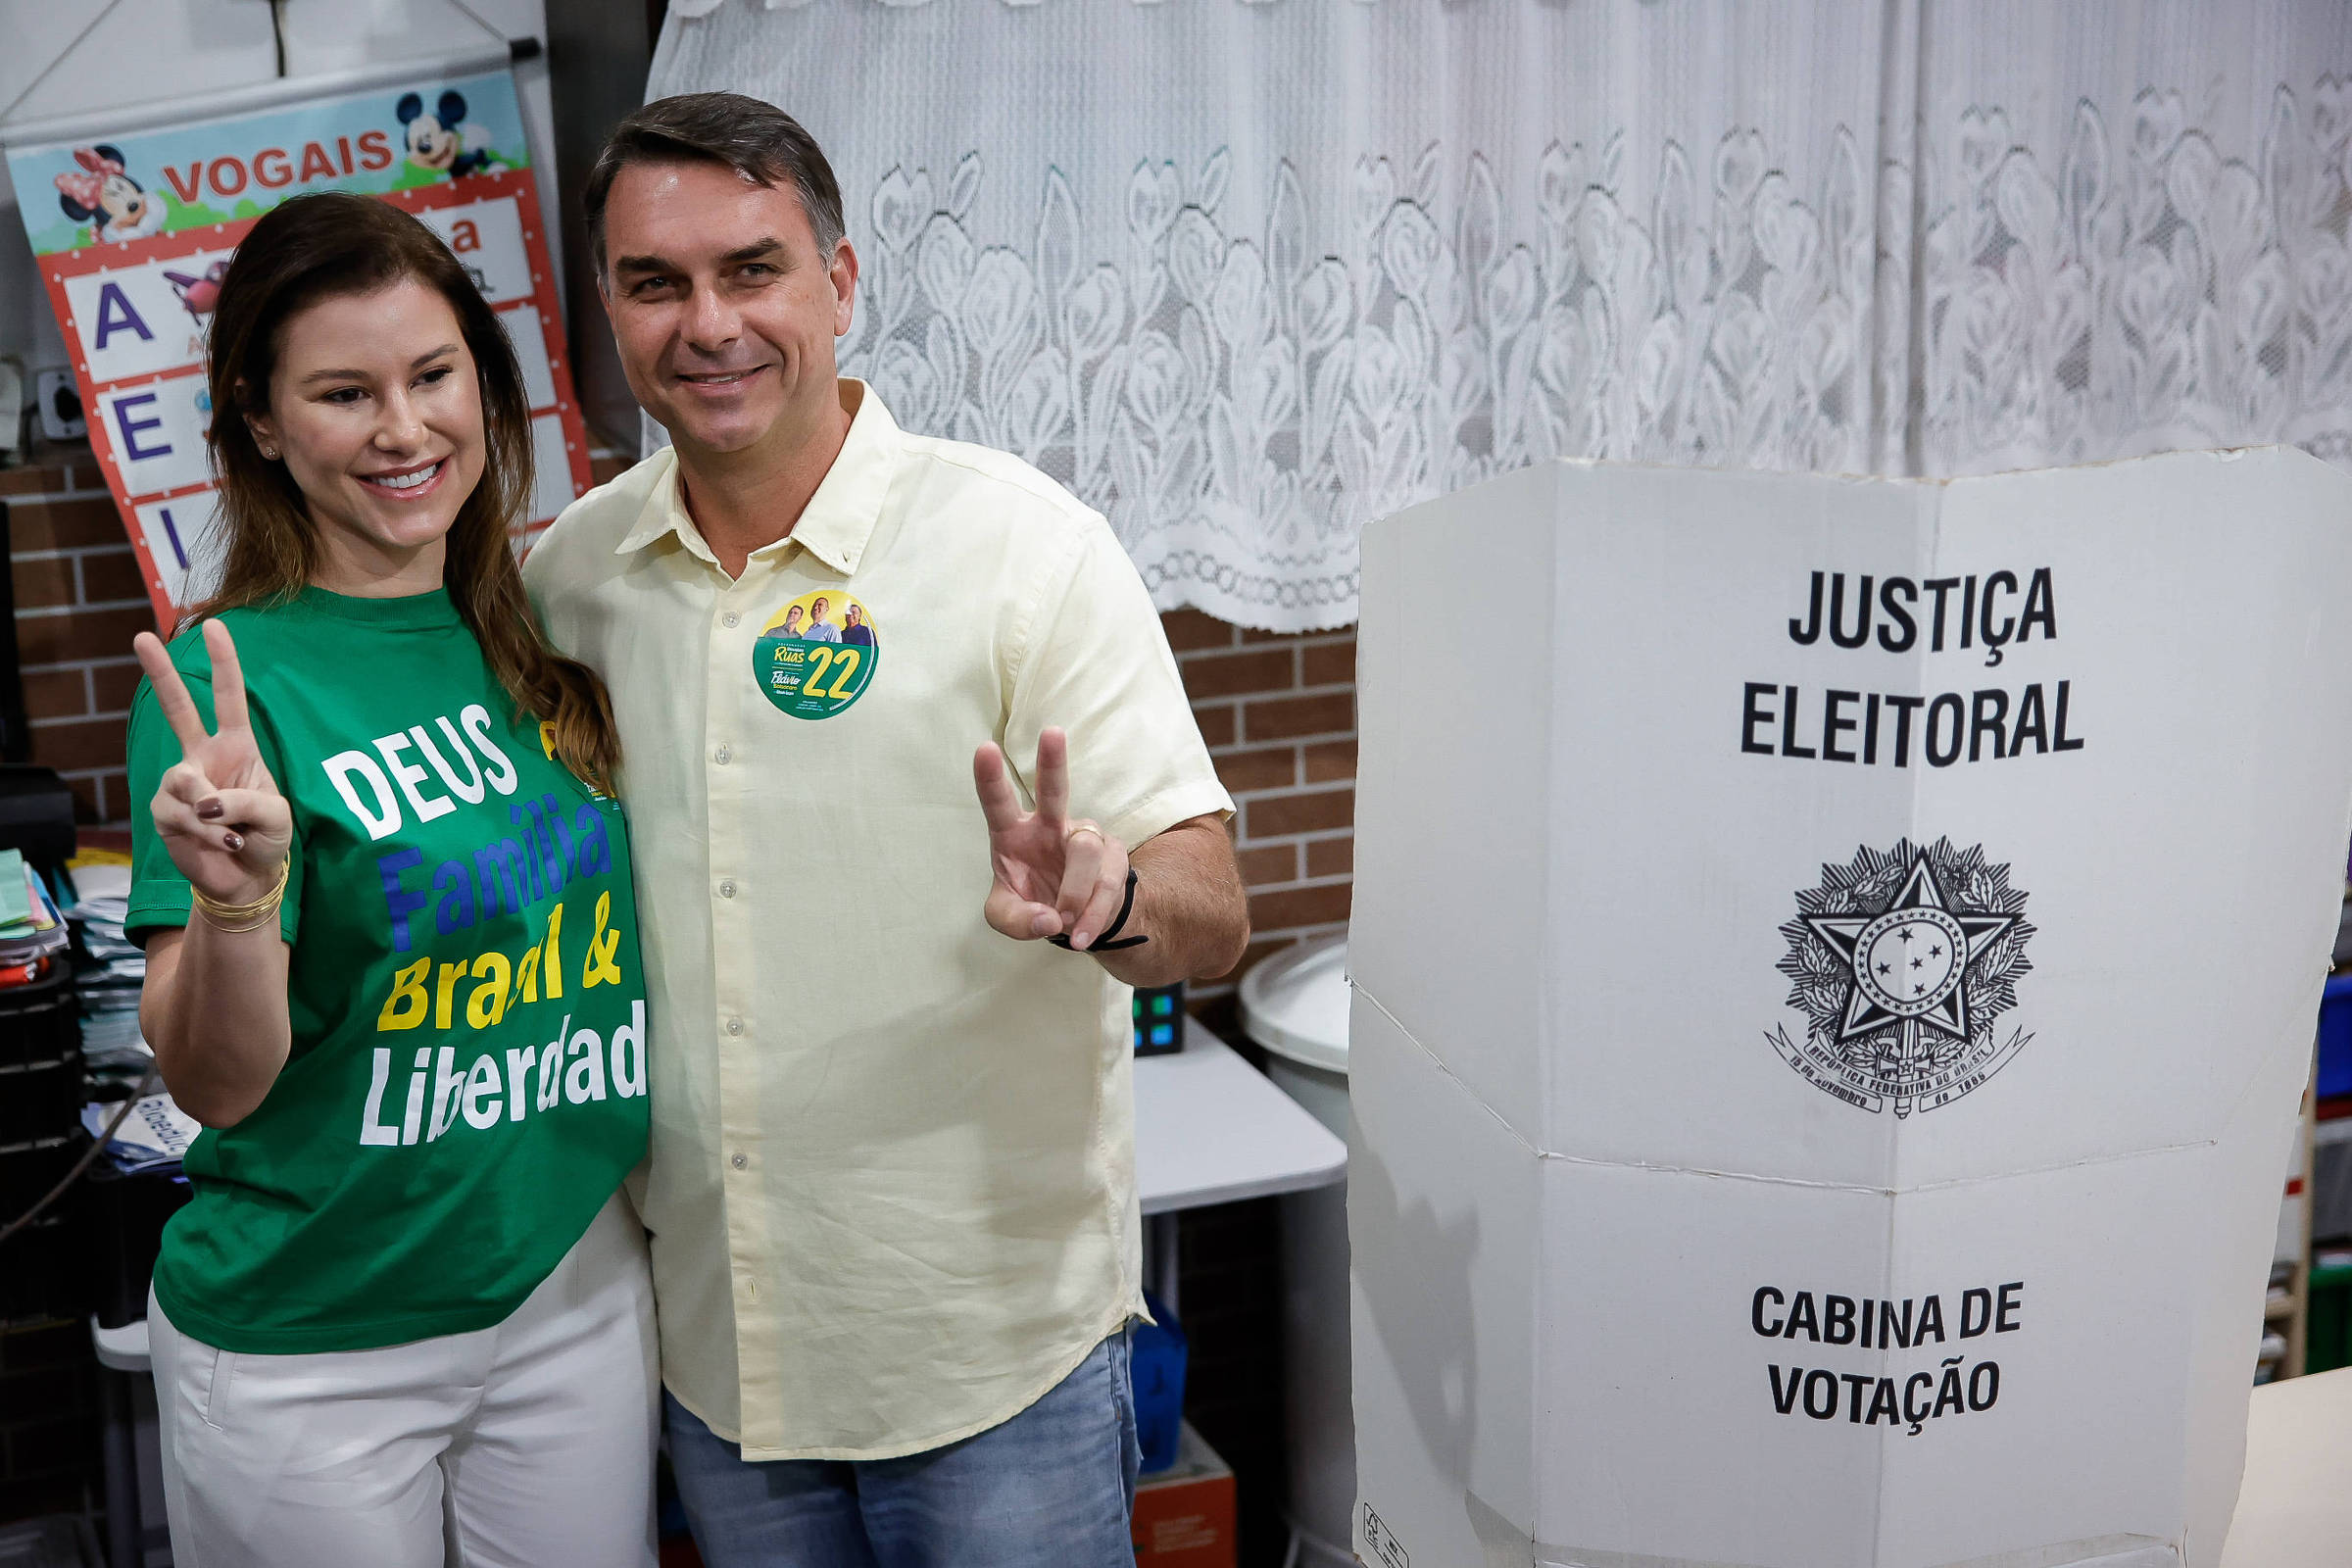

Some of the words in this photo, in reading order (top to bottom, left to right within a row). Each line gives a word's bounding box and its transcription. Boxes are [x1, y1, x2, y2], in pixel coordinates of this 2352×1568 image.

[164, 130, 393, 204] VOGAIS
[451, 219, 481, 254] a
[96, 280, 154, 351] A
[113, 393, 172, 461] E
[160, 509, 188, 569] I
[1788, 567, 2057, 666] JUSTIÇA
[774, 646, 805, 663] Ruas
[803, 646, 860, 700] 22
[1740, 680, 2084, 767] ELEITORAL
[321, 704, 518, 841] DEUS
[377, 793, 612, 953] Família
[583, 891, 621, 989] &
[1868, 1079, 1932, 1096] FEDERATIVA
[1936, 1072, 1950, 1086] DO
[1751, 1286, 1945, 1349] CABINA
[1959, 1281, 2025, 1339] DE
[1768, 1355, 2000, 1437] VOTAÇÃO
